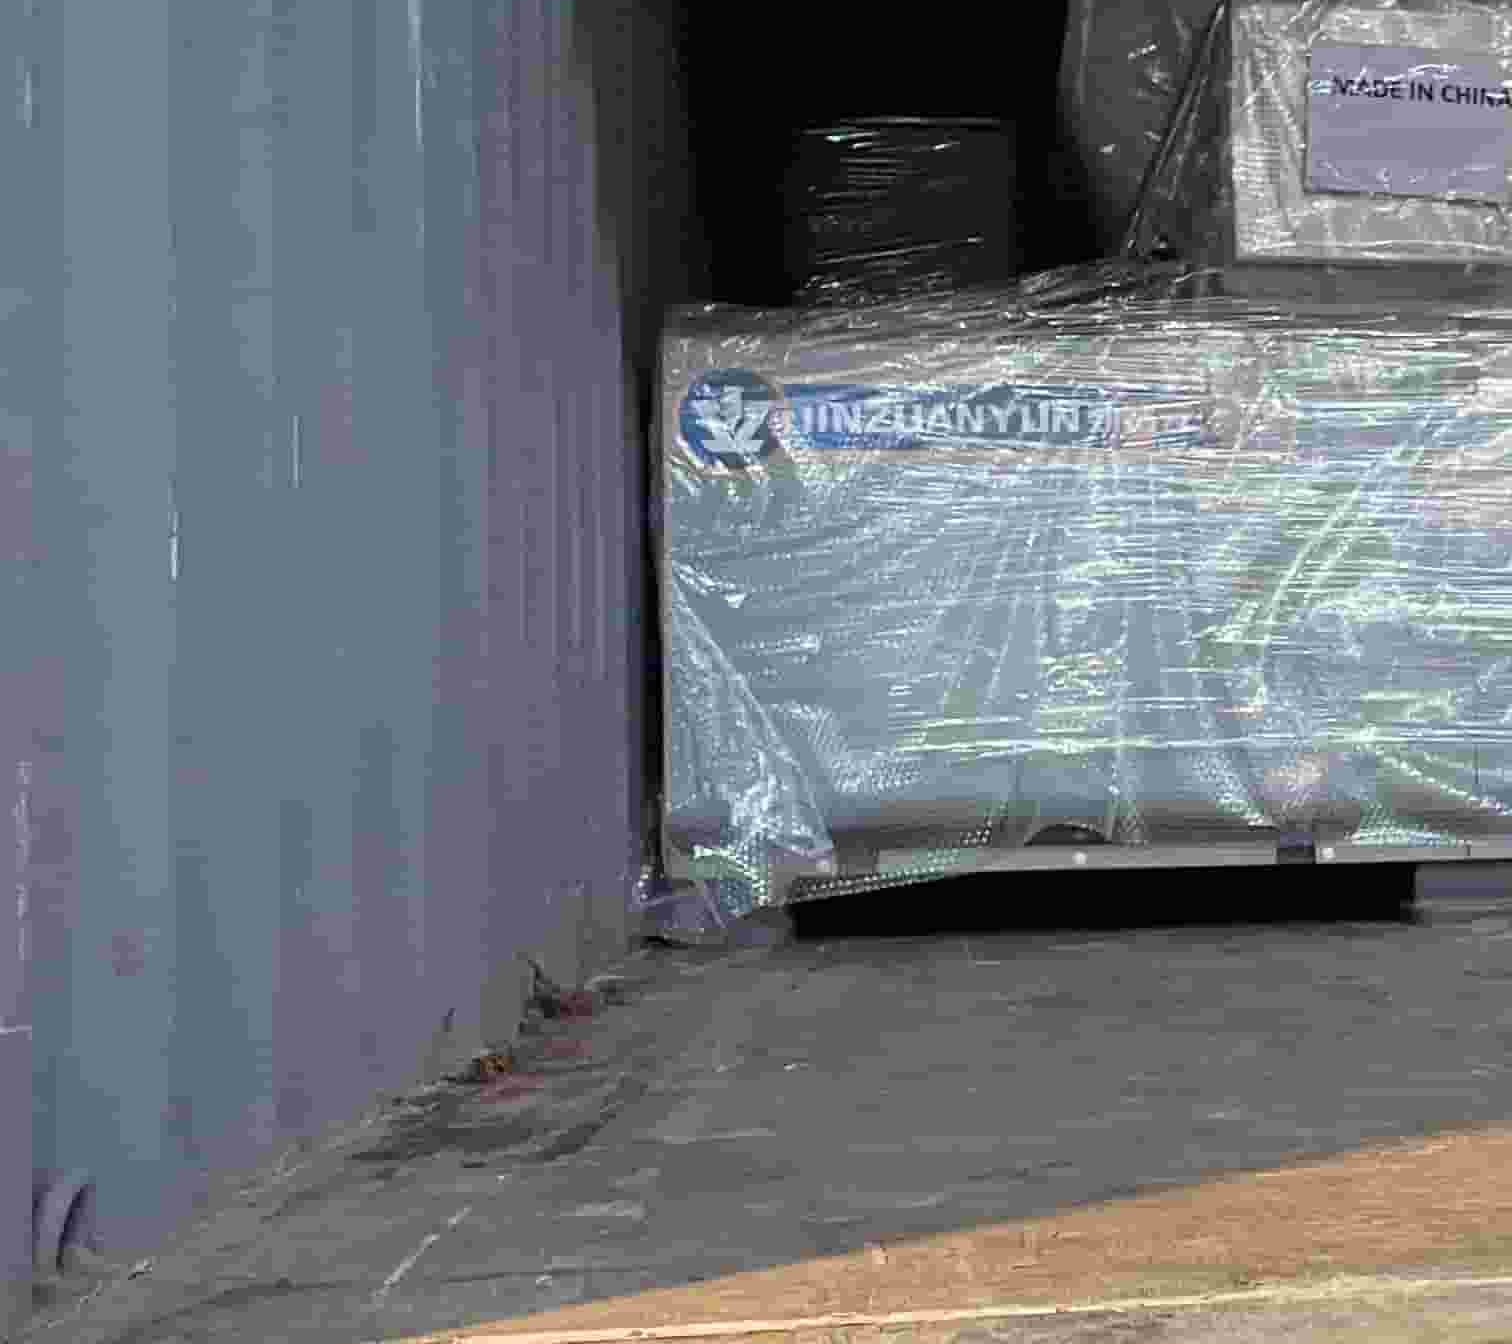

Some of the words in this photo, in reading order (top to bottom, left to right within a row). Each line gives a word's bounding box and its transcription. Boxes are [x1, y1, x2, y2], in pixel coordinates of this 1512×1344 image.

[1330, 75, 1404, 100] MADE
[1408, 79, 1435, 103] IN
[1440, 83, 1512, 109] CHINA
